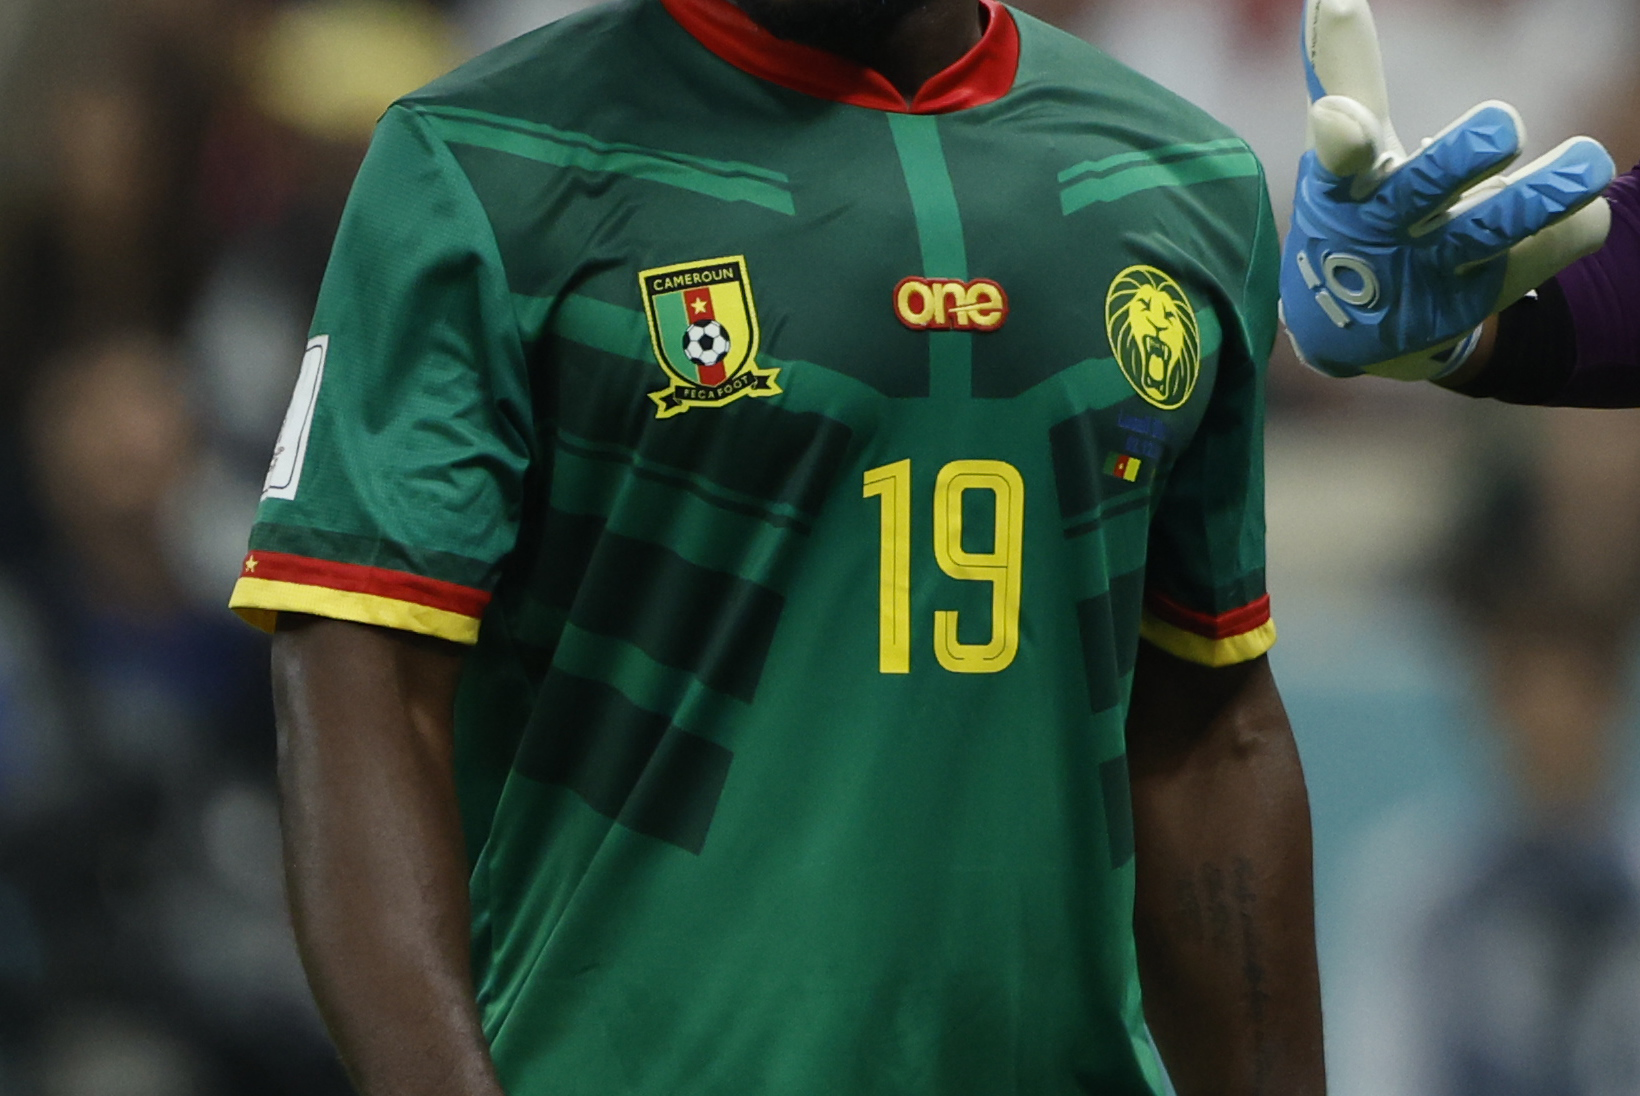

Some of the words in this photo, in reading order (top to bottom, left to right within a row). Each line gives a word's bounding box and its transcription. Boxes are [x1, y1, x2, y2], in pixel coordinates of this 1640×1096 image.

[653, 268, 733, 291] CAMEROUN
[897, 281, 1003, 326] one
[683, 377, 749, 399] FECAFOOT
[863, 458, 1024, 673] 19
